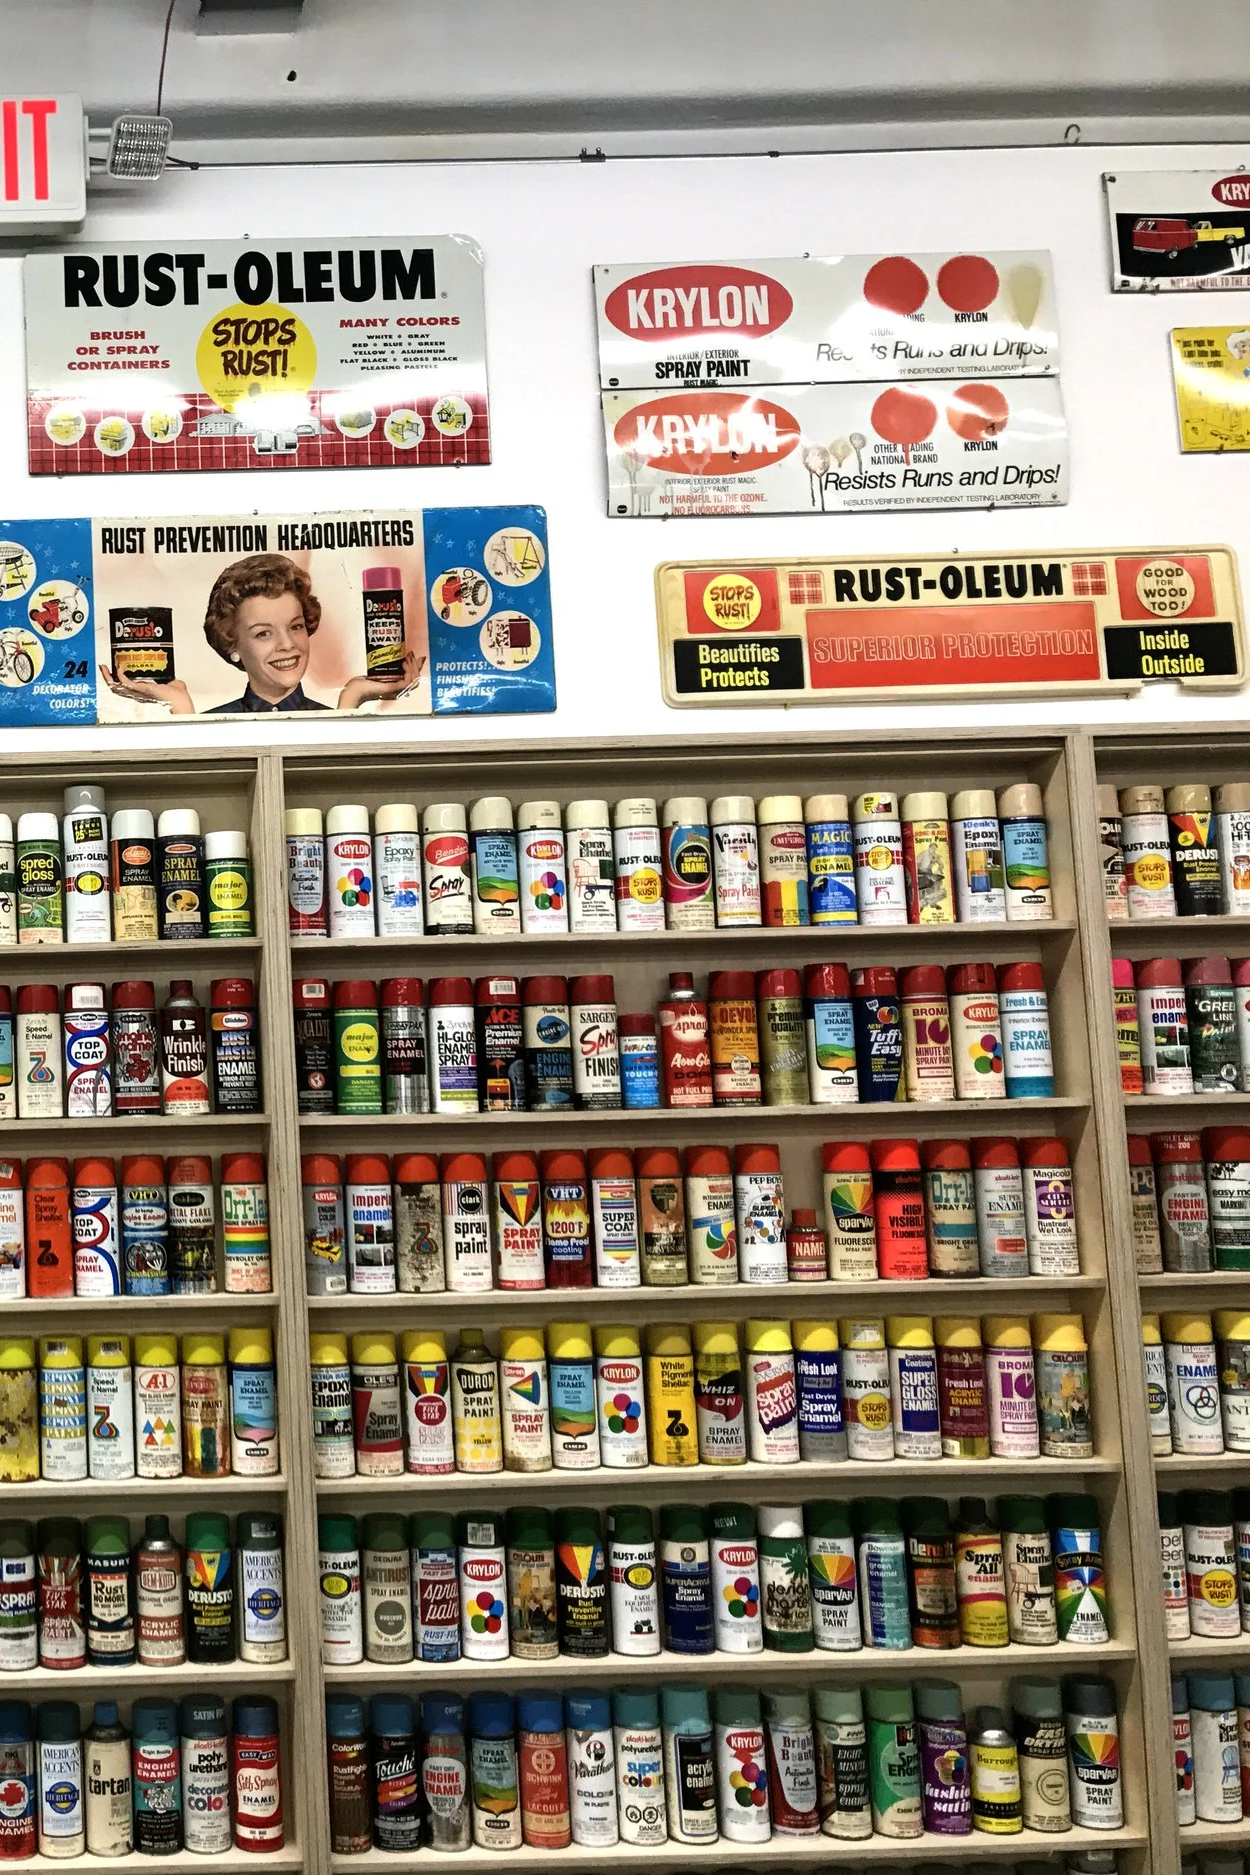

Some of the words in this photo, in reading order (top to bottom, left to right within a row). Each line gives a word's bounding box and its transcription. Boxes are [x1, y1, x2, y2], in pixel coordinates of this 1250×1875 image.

[64, 249, 436, 307] RUST-OLEUM
[628, 285, 769, 329] KRYLON
[340, 318, 389, 329] MANY
[397, 317, 460, 326] COLORS
[954, 312, 988, 323] KRYLON
[90, 331, 146, 341] BRUSH
[212, 318, 296, 348] STOPS
[76, 346, 101, 355] OR
[106, 345, 159, 356] SPRAY
[67, 360, 170, 371] CONTAINERS
[221, 349, 288, 379] RUST!
[655, 360, 706, 379] SPRAY
[708, 360, 750, 377] PAINT
[874, 444, 899, 453] OTHER
[964, 441, 998, 452] KRYLON
[911, 453, 938, 464] BRAND
[823, 470, 896, 492] Resists
[902, 470, 955, 487] Runs
[960, 469, 998, 485] and
[1003, 465, 1060, 485] Drips!
[917, 495, 964, 504] INDEPENDENT
[965, 494, 993, 502] TESTING
[995, 492, 1041, 502] LABORATORY
[101, 527, 146, 553] RUST
[154, 524, 267, 552] PREVENTION
[278, 520, 414, 550] HEADQUARTERS
[1143, 568, 1184, 579] GOOD
[836, 564, 1065, 602] RUST-OLEUM
[1158, 578, 1173, 586] FOR
[710, 585, 754, 603] STOPS
[1145, 587, 1187, 598] WOOD
[715, 601, 752, 619] RUST!
[1151, 600, 1185, 612] TOO!
[368, 620, 400, 629] KEEPS
[371, 628, 398, 636] RUST
[370, 635, 401, 644] AWAY!
[1139, 630, 1189, 651] Inside
[814, 631, 935, 665] SUPERIOR
[946, 628, 1094, 659] PROTECTION
[699, 644, 779, 665] Beautifies
[1141, 653, 1205, 674] Outside
[64, 661, 89, 679] 24
[701, 666, 770, 688] Protects
[32, 685, 89, 695] DECORATOR
[50, 698, 90, 709] COLORS!
[339, 844, 370, 855] KRYLON
[164, 858, 198, 870] SPRAY
[162, 869, 201, 881] ENAMEL
[77, 1041, 100, 1050] TOP
[75, 1050, 104, 1059] COAT
[550, 1189, 579, 1199] VHT
[461, 1195, 481, 1205] clark
[454, 1222, 487, 1239] spray
[503, 1228, 541, 1239] SPRAY
[455, 1239, 488, 1259] paint
[504, 1239, 541, 1249] PAINT
[603, 1368, 637, 1379] KRYLON
[902, 1372, 936, 1386] SUPER
[701, 1385, 735, 1394] WHIZ
[903, 1386, 937, 1400] GLOSS
[716, 1398, 735, 1406] ON
[903, 1401, 937, 1411] ENAMEL
[466, 1565, 501, 1577] KRYLON
[822, 1609, 848, 1618] SPRAY
[823, 1618, 848, 1627] PAINT
[425, 1772, 460, 1783] ENGINE
[89, 1775, 129, 1795] tartan
[424, 1783, 462, 1795] ENAMEL
